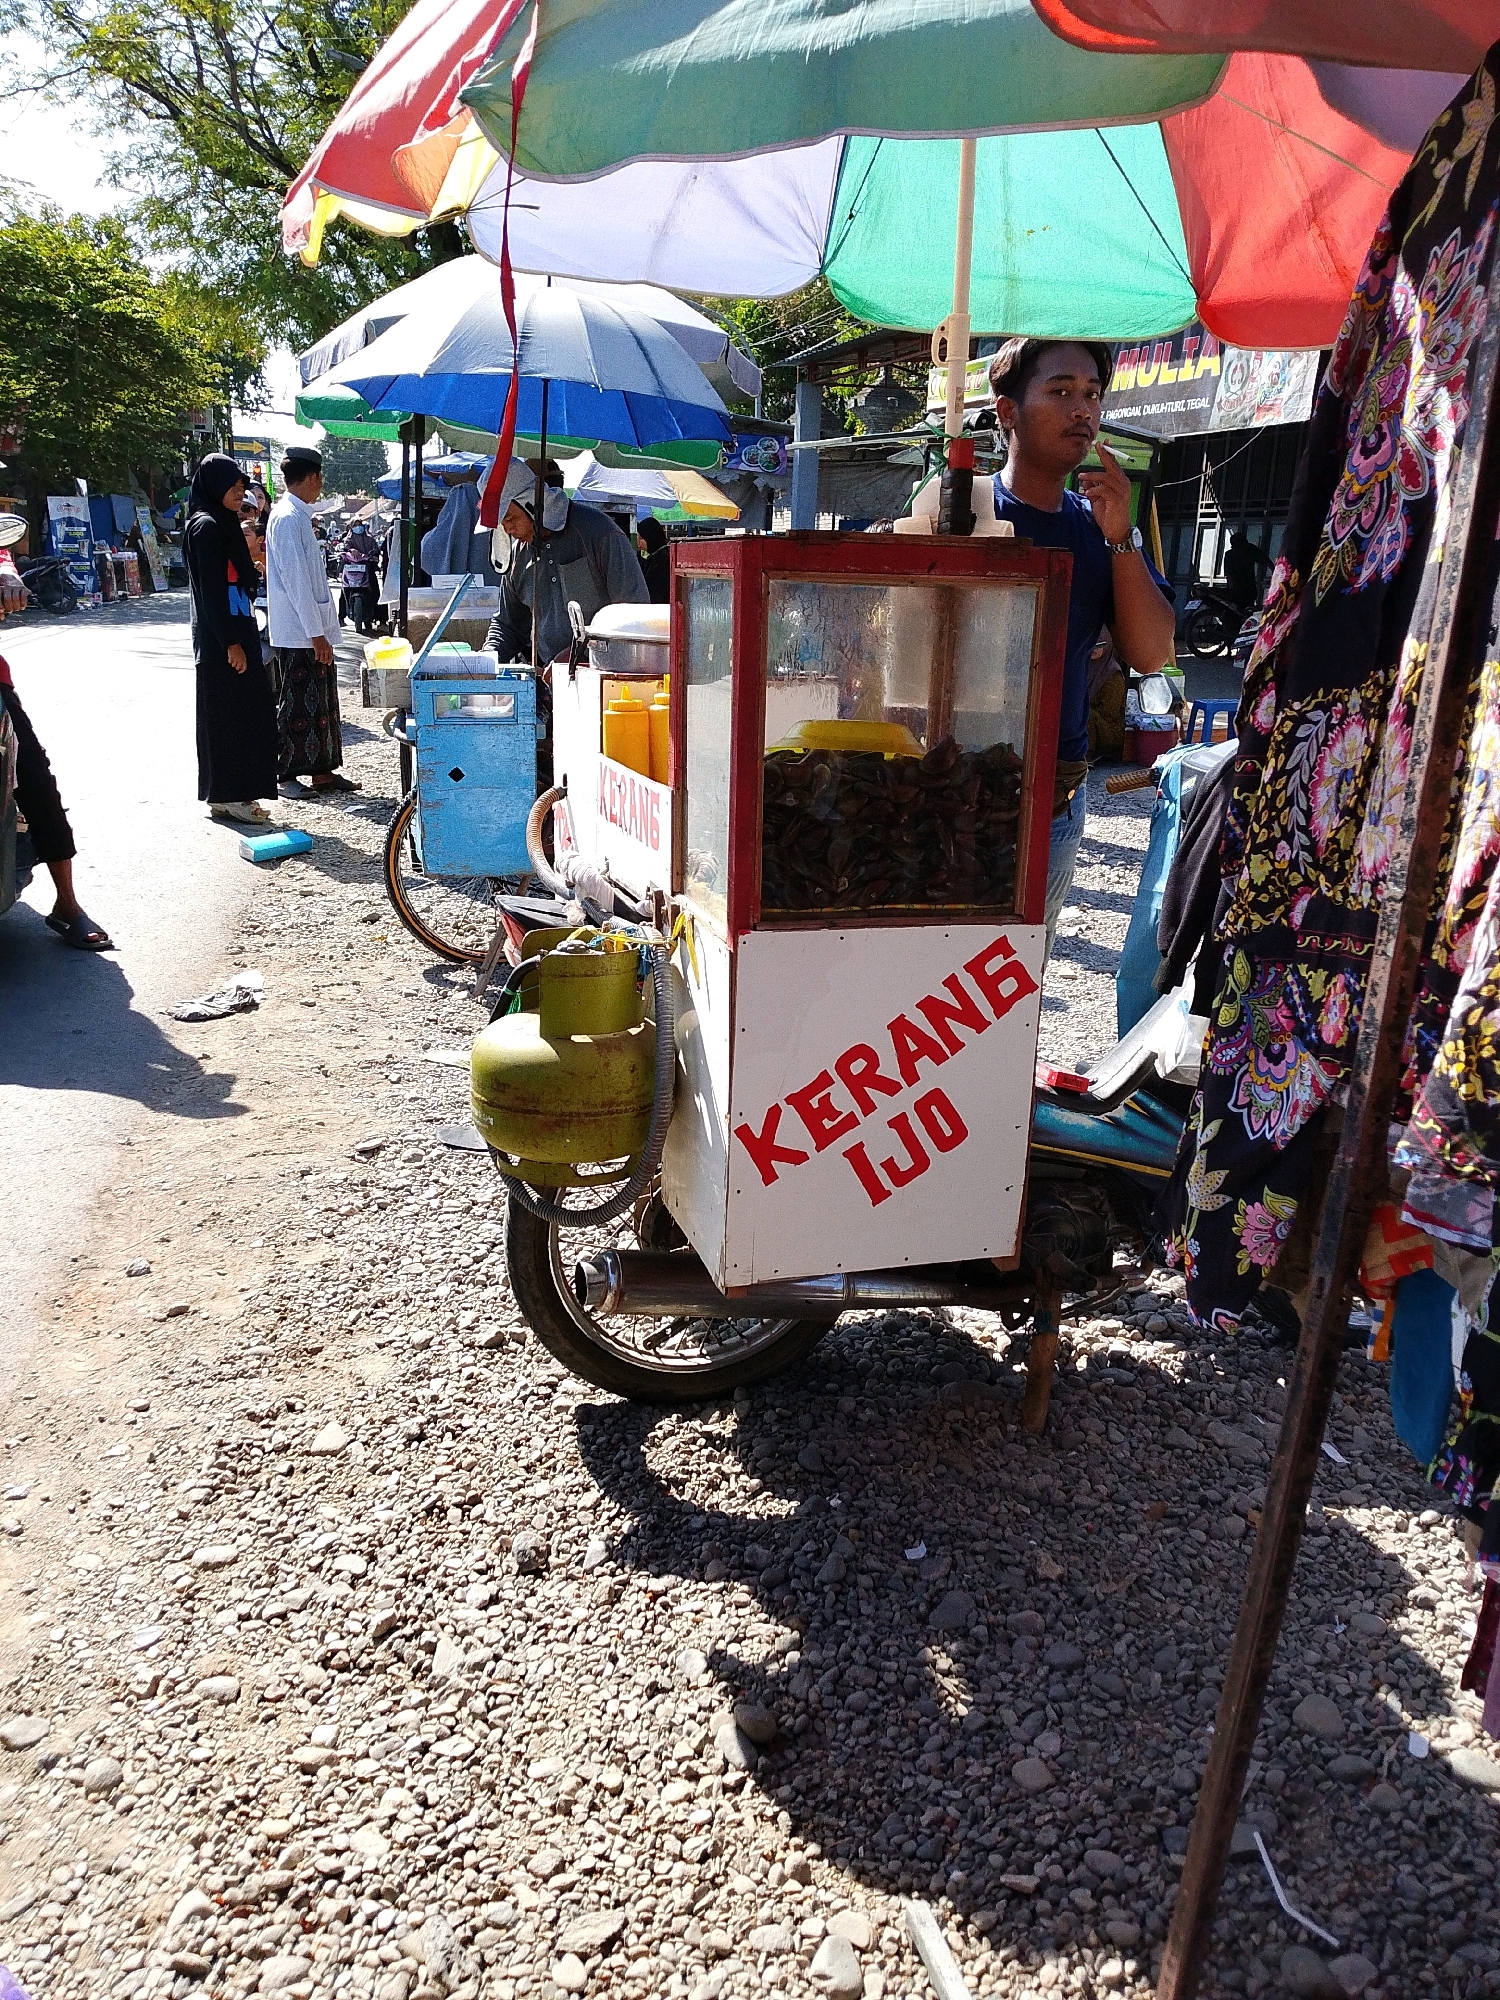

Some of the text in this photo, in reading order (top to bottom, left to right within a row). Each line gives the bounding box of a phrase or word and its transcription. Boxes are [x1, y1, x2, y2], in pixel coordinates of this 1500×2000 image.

[1111, 333, 1221, 392] MULIA
[1186, 396, 1211, 411] TEGAL
[600, 762, 660, 851] KERANG
[733, 934, 1040, 1187] KERANG
[842, 1087, 969, 1208] IJO
